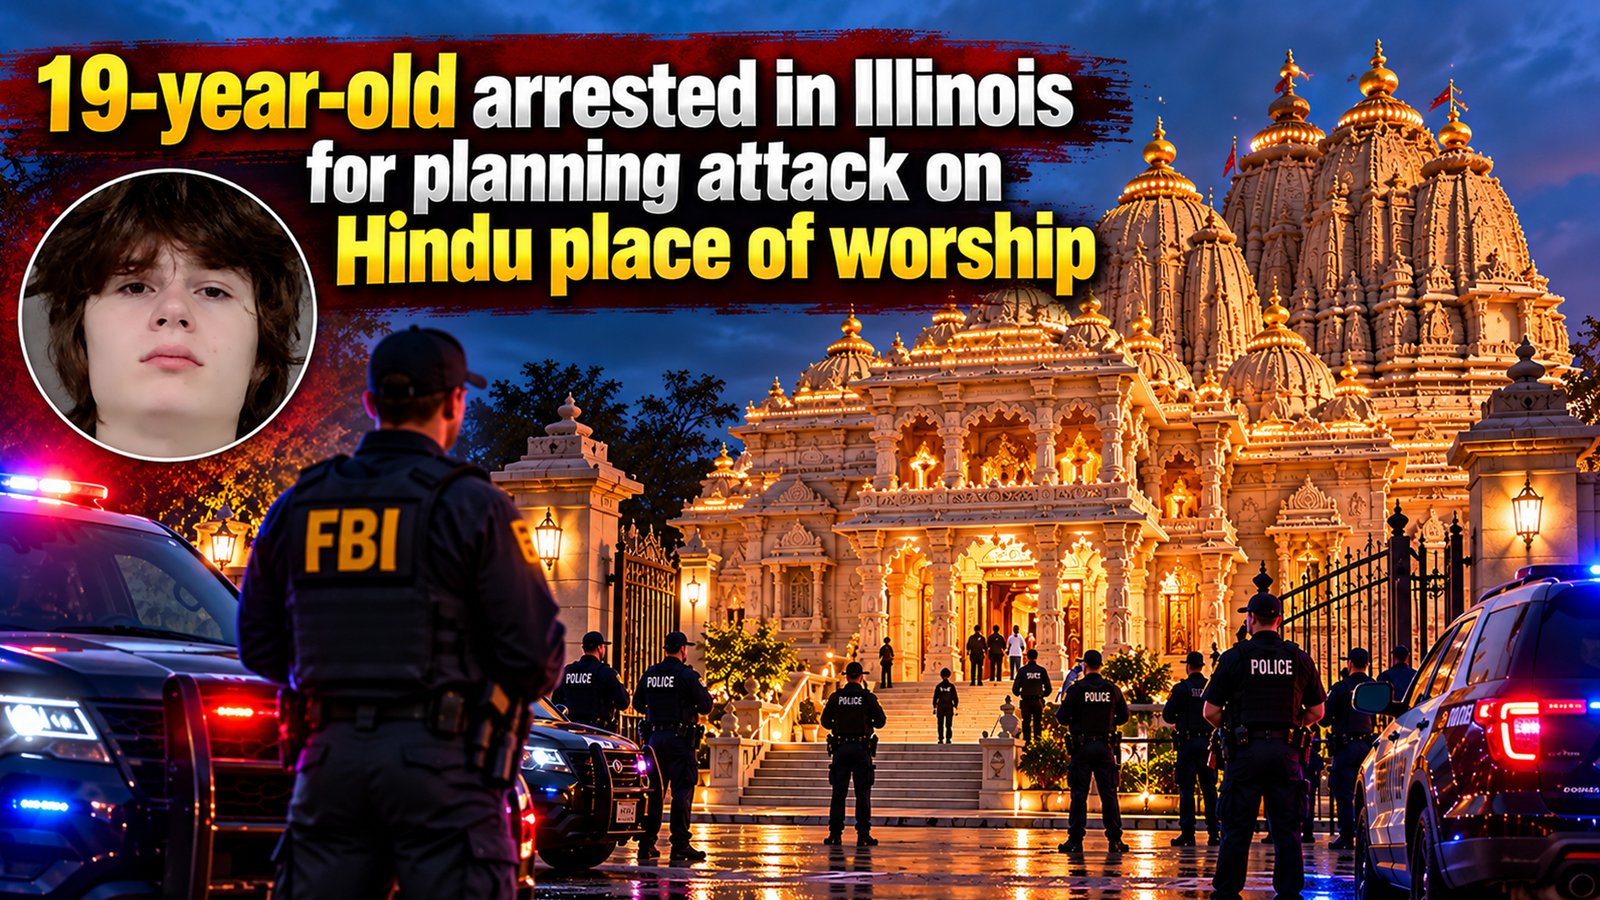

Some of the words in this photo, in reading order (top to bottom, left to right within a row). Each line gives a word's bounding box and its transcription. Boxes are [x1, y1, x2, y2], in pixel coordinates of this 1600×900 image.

[305, 508, 400, 573] FBI
[1250, 658, 1293, 676] POLICE
[565, 672, 593, 684] POLICE
[646, 676, 675, 688] POLICE
[838, 696, 863, 705] POLICE
[1084, 691, 1111, 703] POLICE
